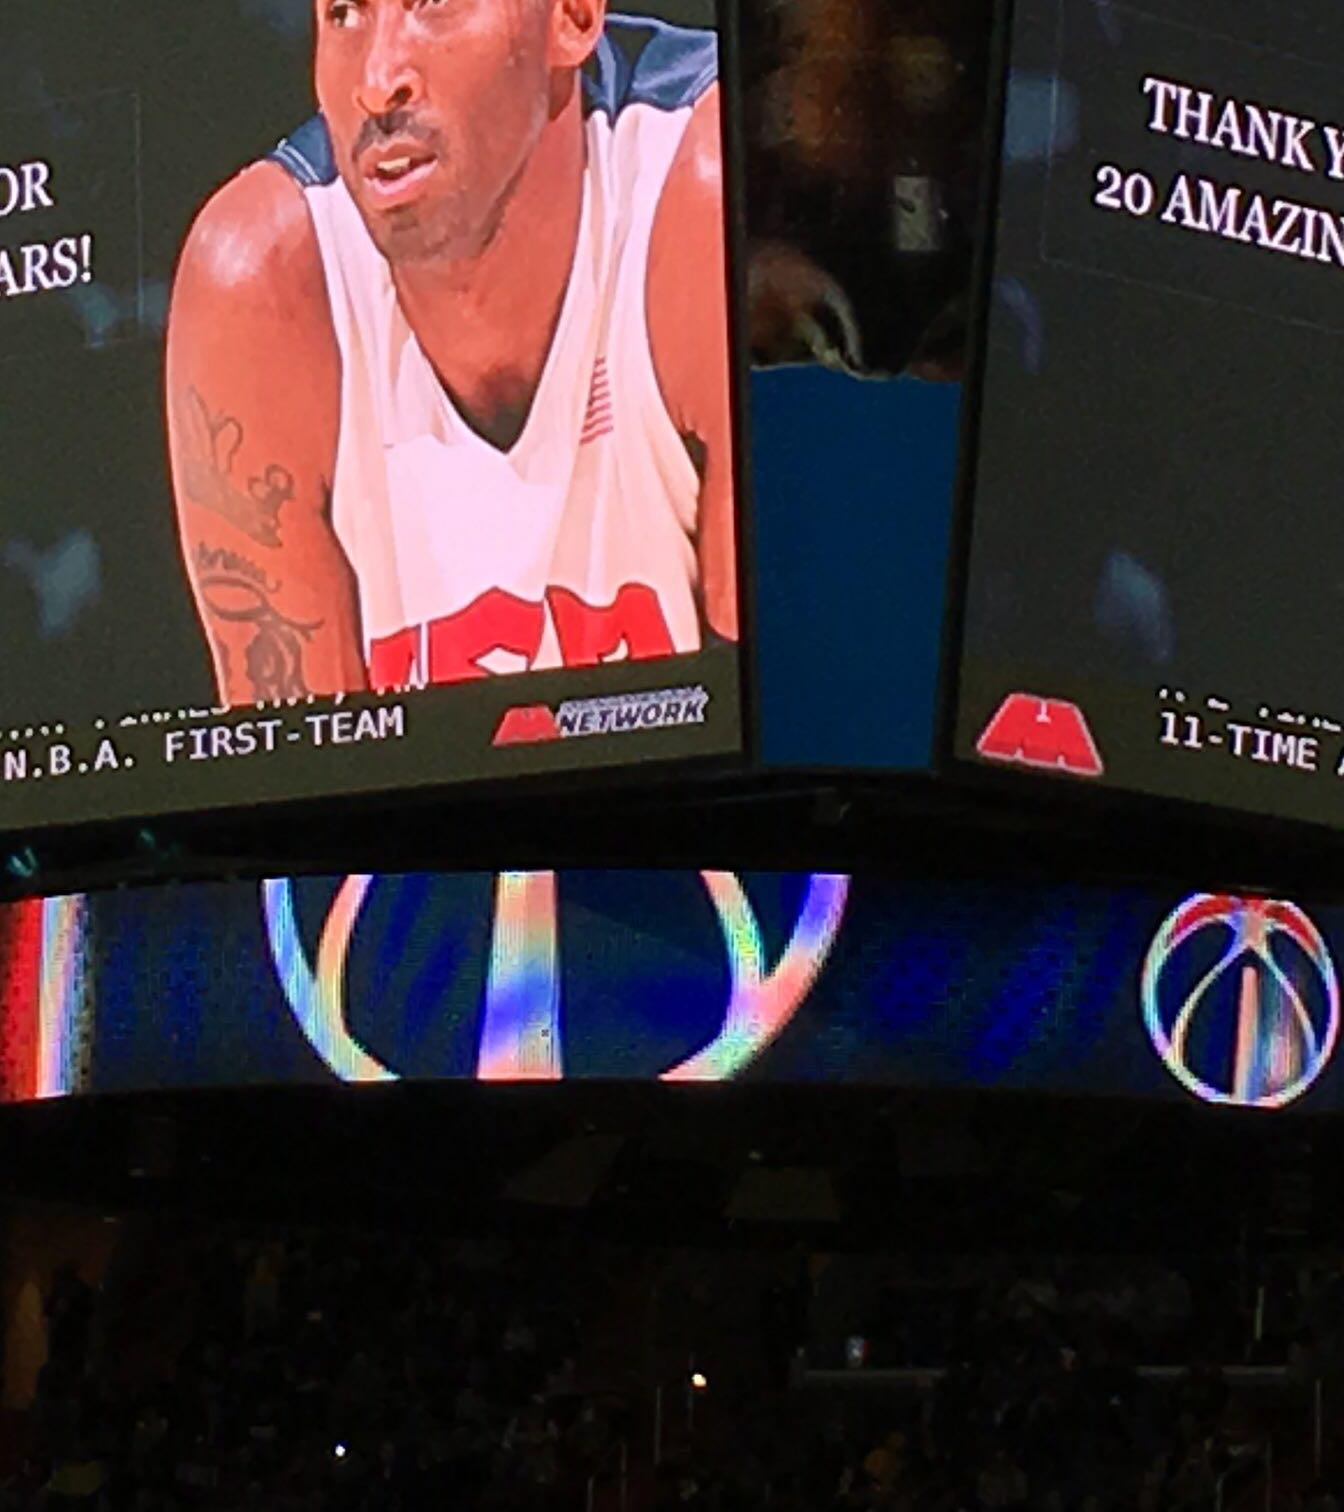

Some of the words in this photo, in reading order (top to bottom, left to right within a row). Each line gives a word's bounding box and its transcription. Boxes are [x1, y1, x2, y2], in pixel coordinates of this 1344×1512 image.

[1143, 78, 1315, 173] THANK
[1095, 166, 1153, 217] 20
[164, 705, 404, 763] FIRST-TEAM
[560, 696, 705, 736] NETWORK
[1160, 711, 1317, 770] 11-TIME
